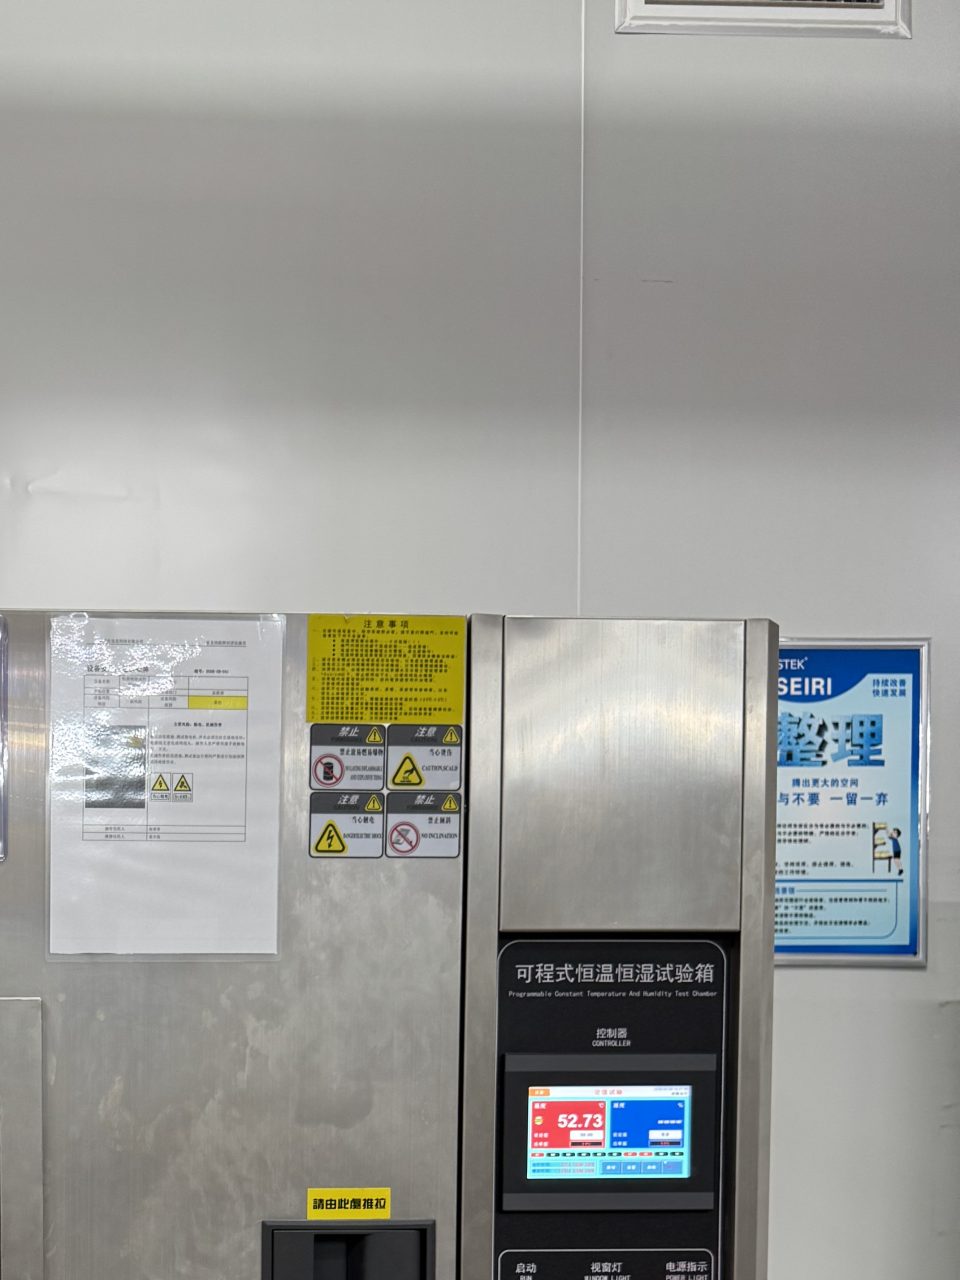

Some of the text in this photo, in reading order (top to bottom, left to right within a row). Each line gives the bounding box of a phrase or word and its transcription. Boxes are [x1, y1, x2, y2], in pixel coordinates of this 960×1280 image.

[873, 678, 906, 688] 持续改善
[873, 688, 906, 697] 快速发展
[339, 726, 359, 737] 禁止
[415, 726, 437, 737] 注意
[777, 712, 885, 767] 整理
[792, 778, 859, 788] 腾出更大的空间
[338, 794, 360, 805] 注意
[414, 795, 435, 805] 禁止
[515, 963, 715, 984] 可程式恒温恒湿试验箱
[554, 990, 583, 998] Constant
[587, 990, 626, 998] Temperature
[643, 990, 672, 998] Humidity
[596, 1028, 628, 1039] 控制器
[558, 1114, 603, 1129] 52.73
[516, 1262, 536, 1274] 启动
[590, 1262, 622, 1273] 视窗灯
[666, 1261, 708, 1272] 电源指示
